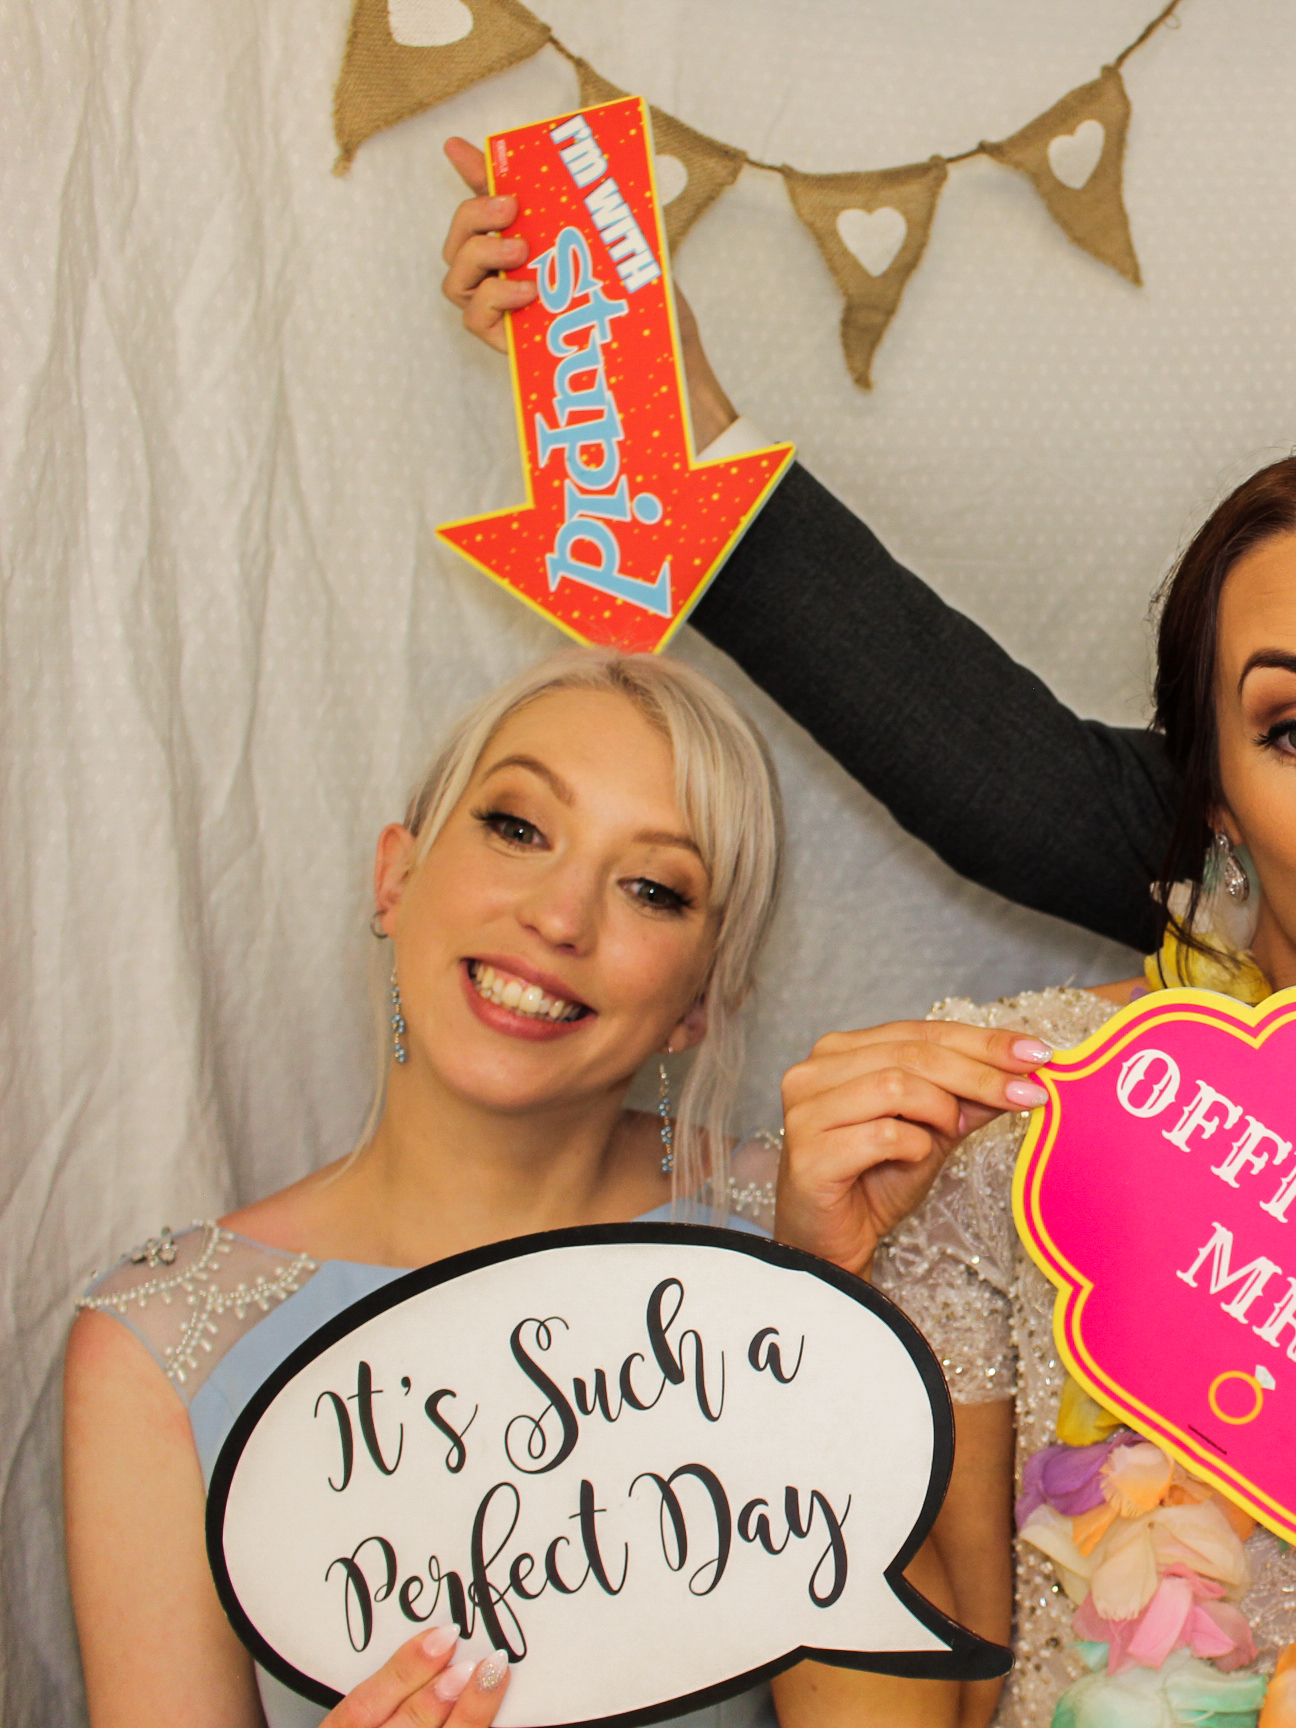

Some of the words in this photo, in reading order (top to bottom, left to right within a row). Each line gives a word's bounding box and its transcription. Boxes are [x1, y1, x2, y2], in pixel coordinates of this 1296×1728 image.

[583, 176, 663, 294] WITH
[527, 226, 673, 619] stupid
[313, 1360, 479, 1493] It's
[504, 1277, 725, 1475] Such
[747, 1326, 805, 1384] a
[324, 1479, 629, 1665] Perfect
[628, 1463, 852, 1609] Day
